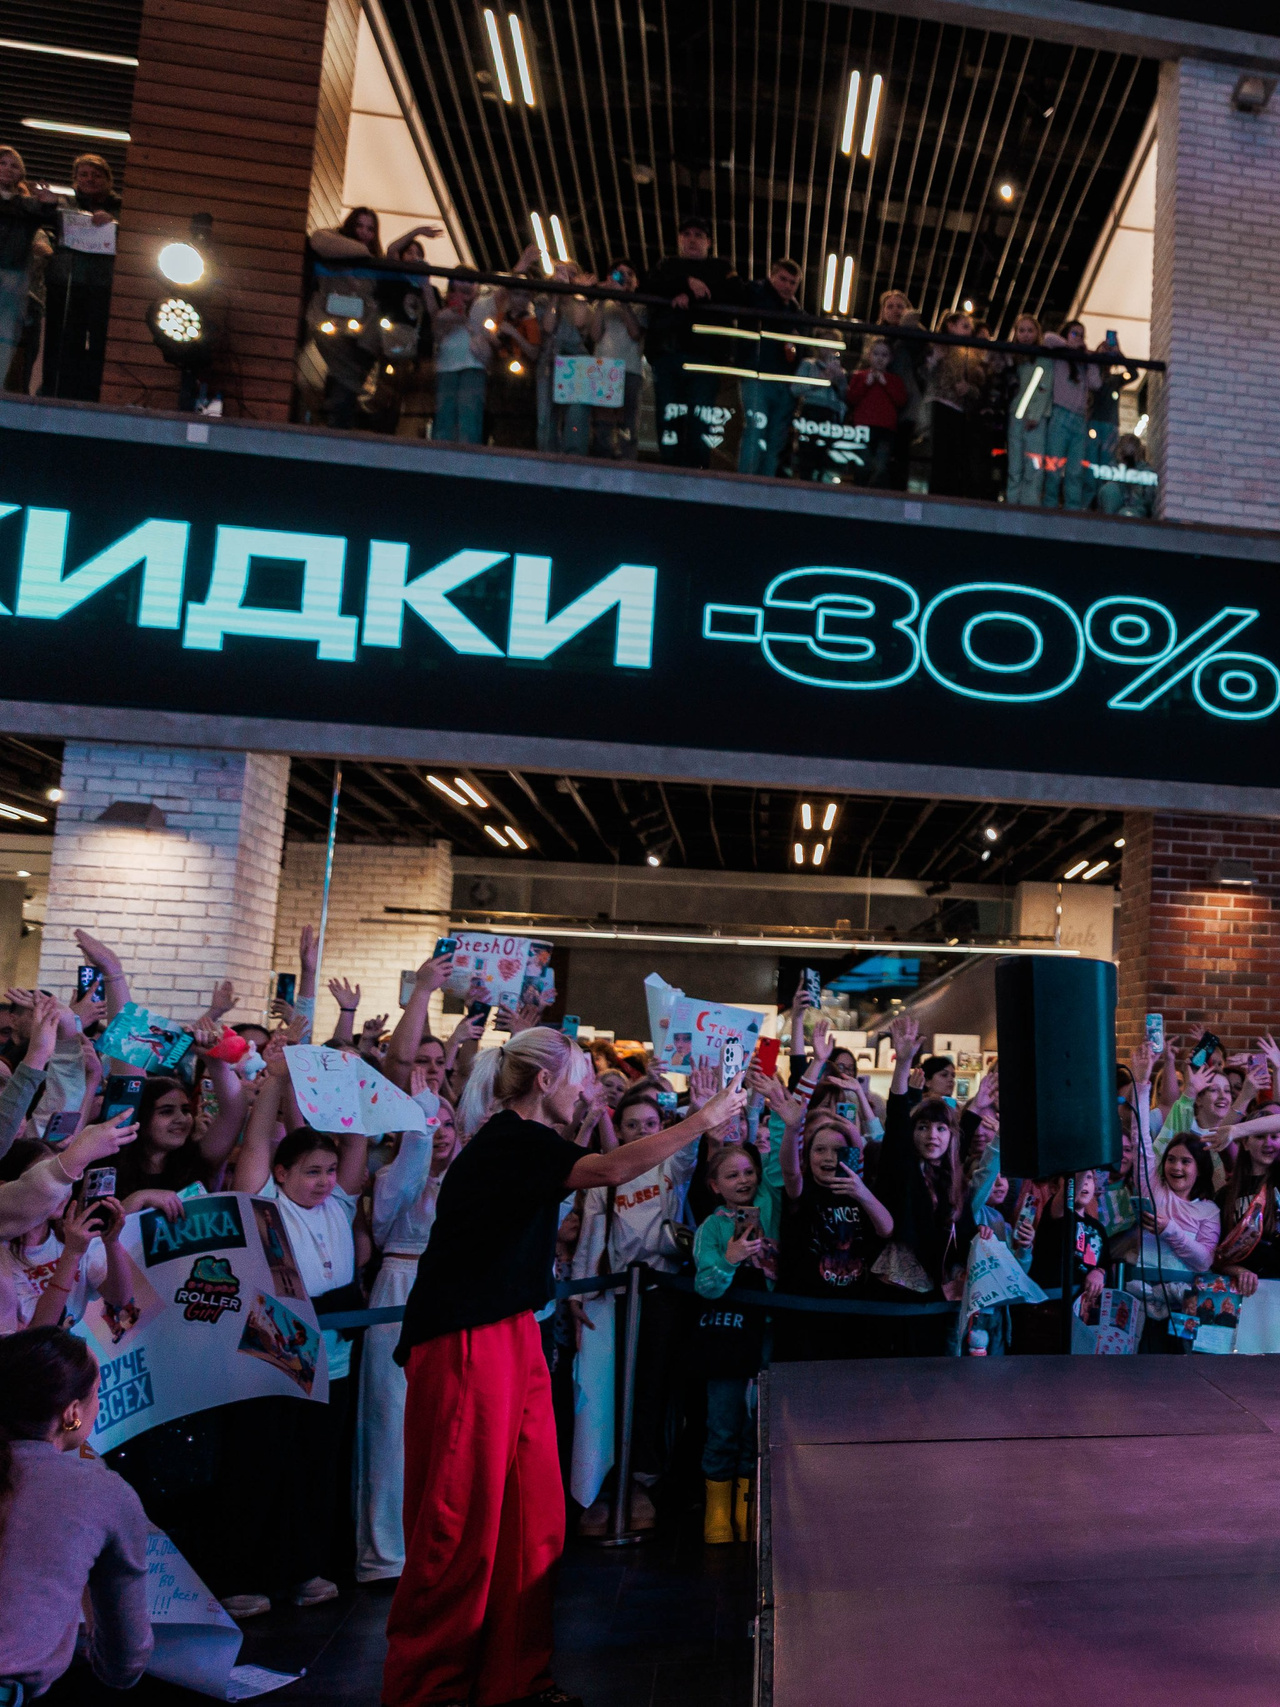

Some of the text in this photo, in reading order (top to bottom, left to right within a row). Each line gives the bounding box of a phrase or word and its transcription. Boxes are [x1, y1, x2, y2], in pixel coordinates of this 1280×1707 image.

[177, 1291, 240, 1310] ROLLER
[185, 1302, 228, 1323] Girl
[700, 1312, 744, 1329] CEER
[97, 1378, 151, 1430] ВСЕХ
